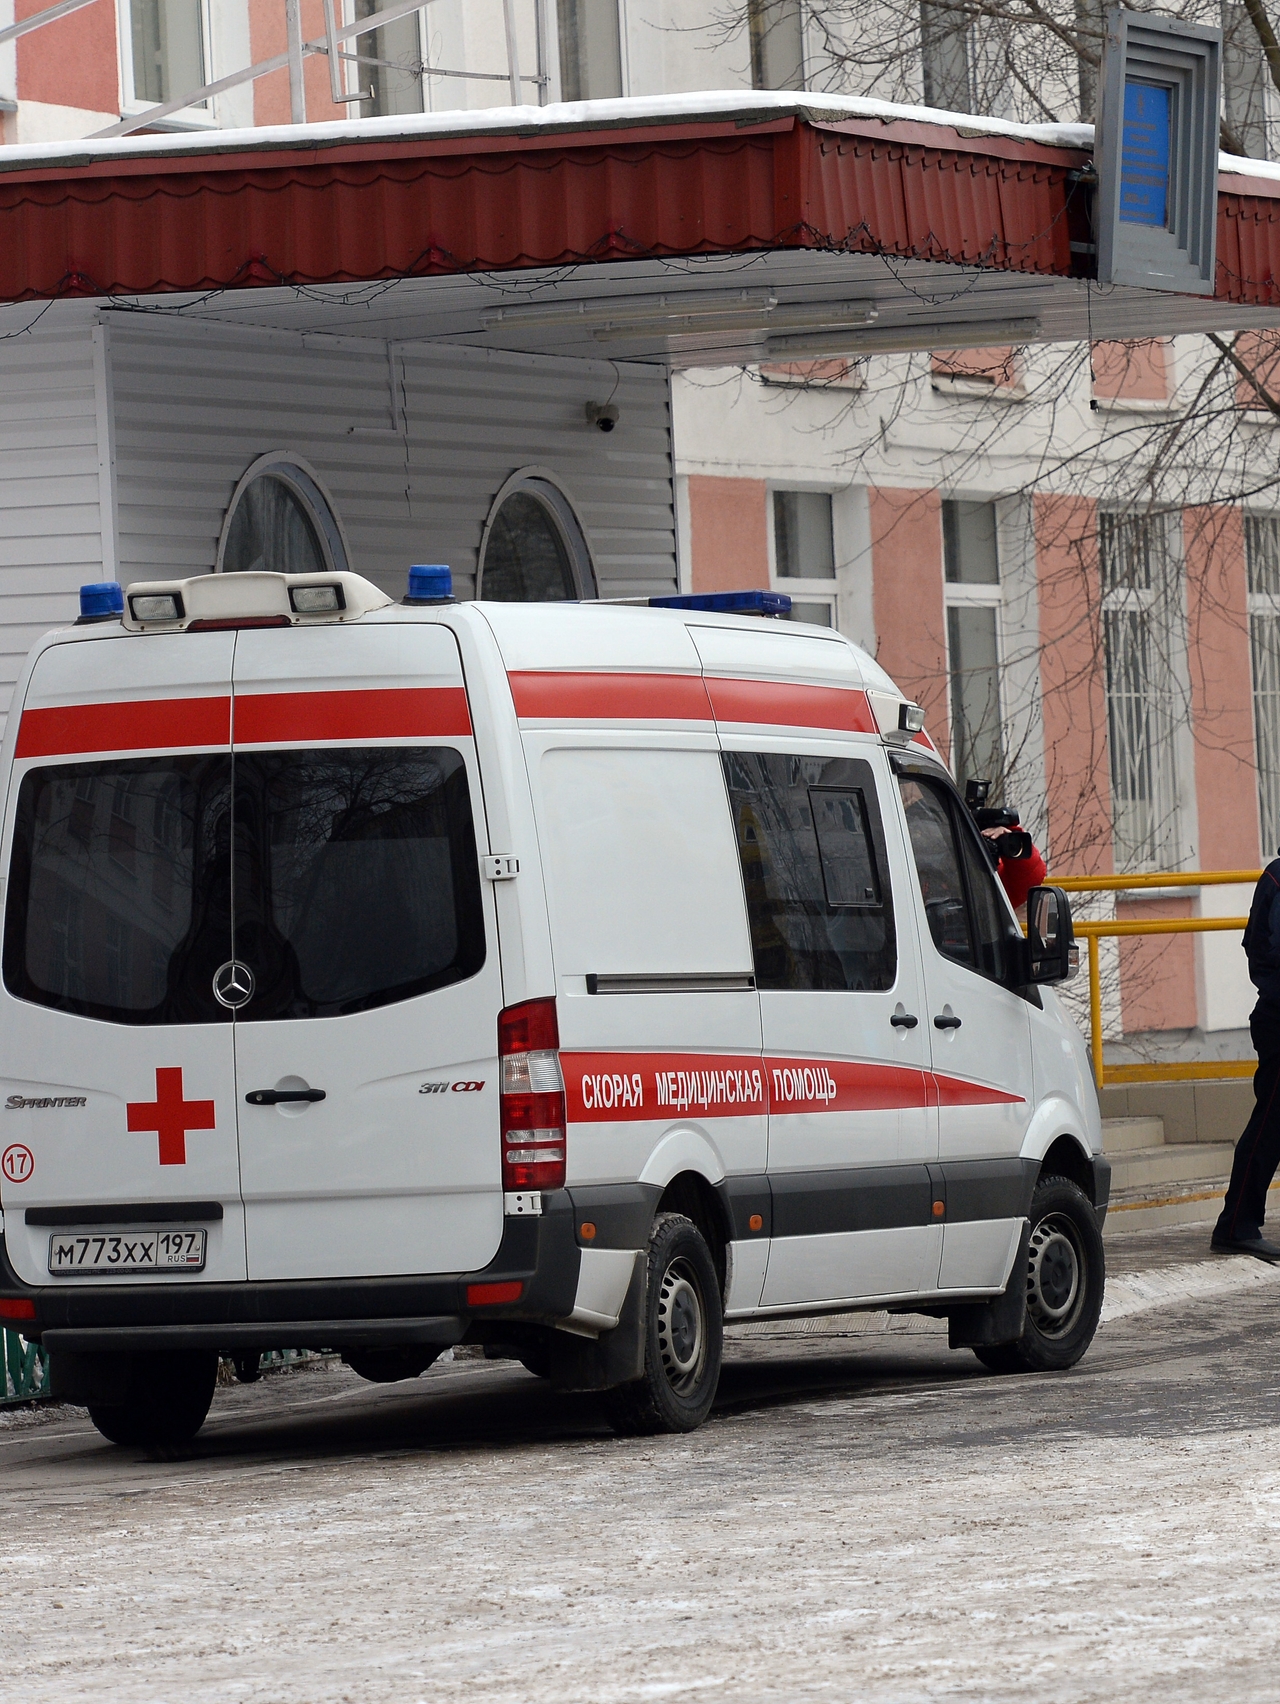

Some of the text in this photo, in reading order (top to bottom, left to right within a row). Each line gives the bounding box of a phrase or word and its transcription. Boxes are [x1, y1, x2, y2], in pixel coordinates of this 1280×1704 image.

[419, 1081, 486, 1094] 311 CDI
[581, 1067, 837, 1111] СКОРАЯ МЕДИЦИНСКАЯ ПОМОЩЬ
[4, 1095, 87, 1110] SPRINTER
[6, 1153, 28, 1175] 17
[160, 1233, 196, 1255] 197
[167, 1254, 186, 1263] RUS
